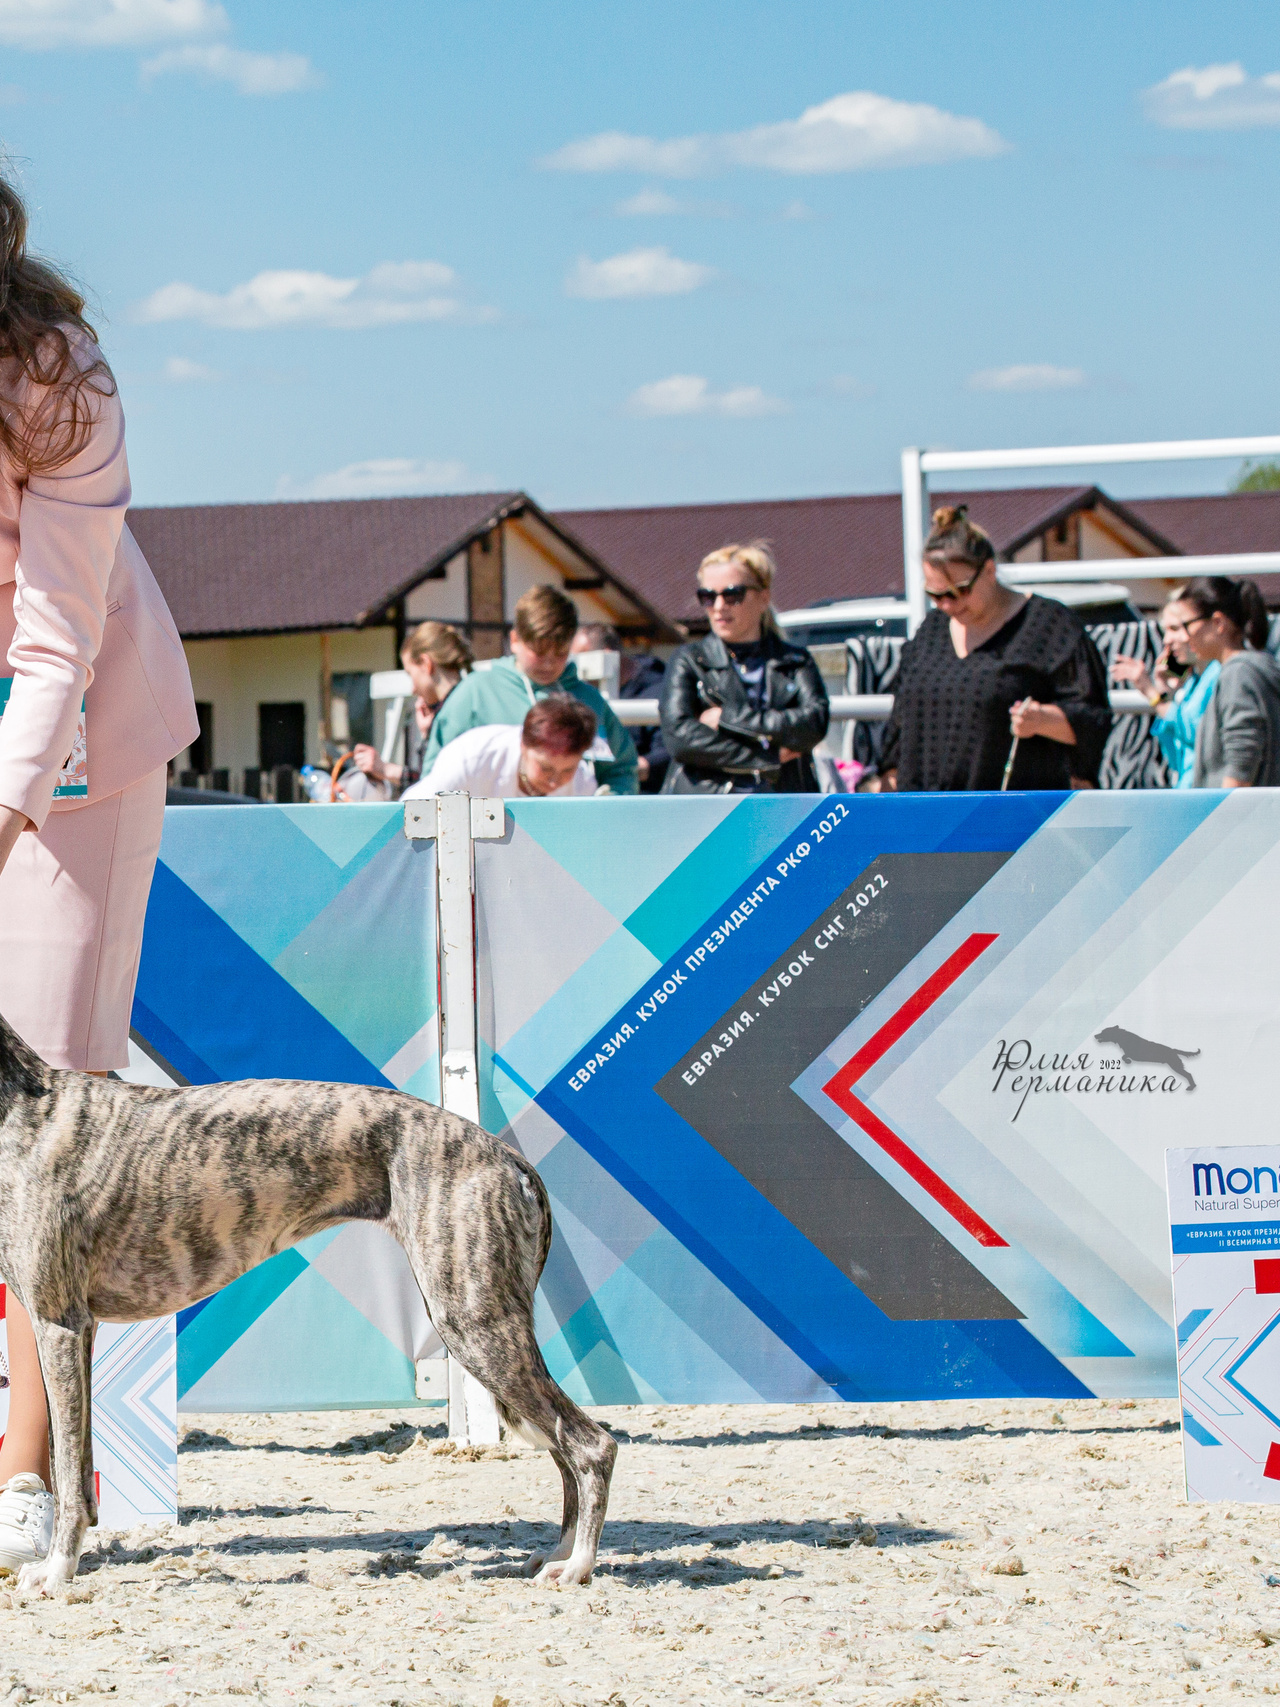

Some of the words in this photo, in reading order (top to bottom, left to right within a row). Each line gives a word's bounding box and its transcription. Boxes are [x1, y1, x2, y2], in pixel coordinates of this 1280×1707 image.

[567, 1022, 640, 1092] ЕВРАЗИЯ.
[635, 968, 689, 1022] КУБОК
[684, 876, 780, 972] ПРЕЗИДЕНТА
[776, 841, 811, 877] РКФ
[810, 803, 850, 843] 2022
[681, 1010, 760, 1086] ЕВРАЗИЯ.
[757, 949, 815, 1008] КУБОК
[814, 914, 846, 951] СНГ
[846, 873, 889, 917] 2022
[1194, 1198, 1240, 1212] Natural
[1227, 1229, 1252, 1237] КУБОК
[1226, 1237, 1272, 1247] ВСЕМИРНАЯ
